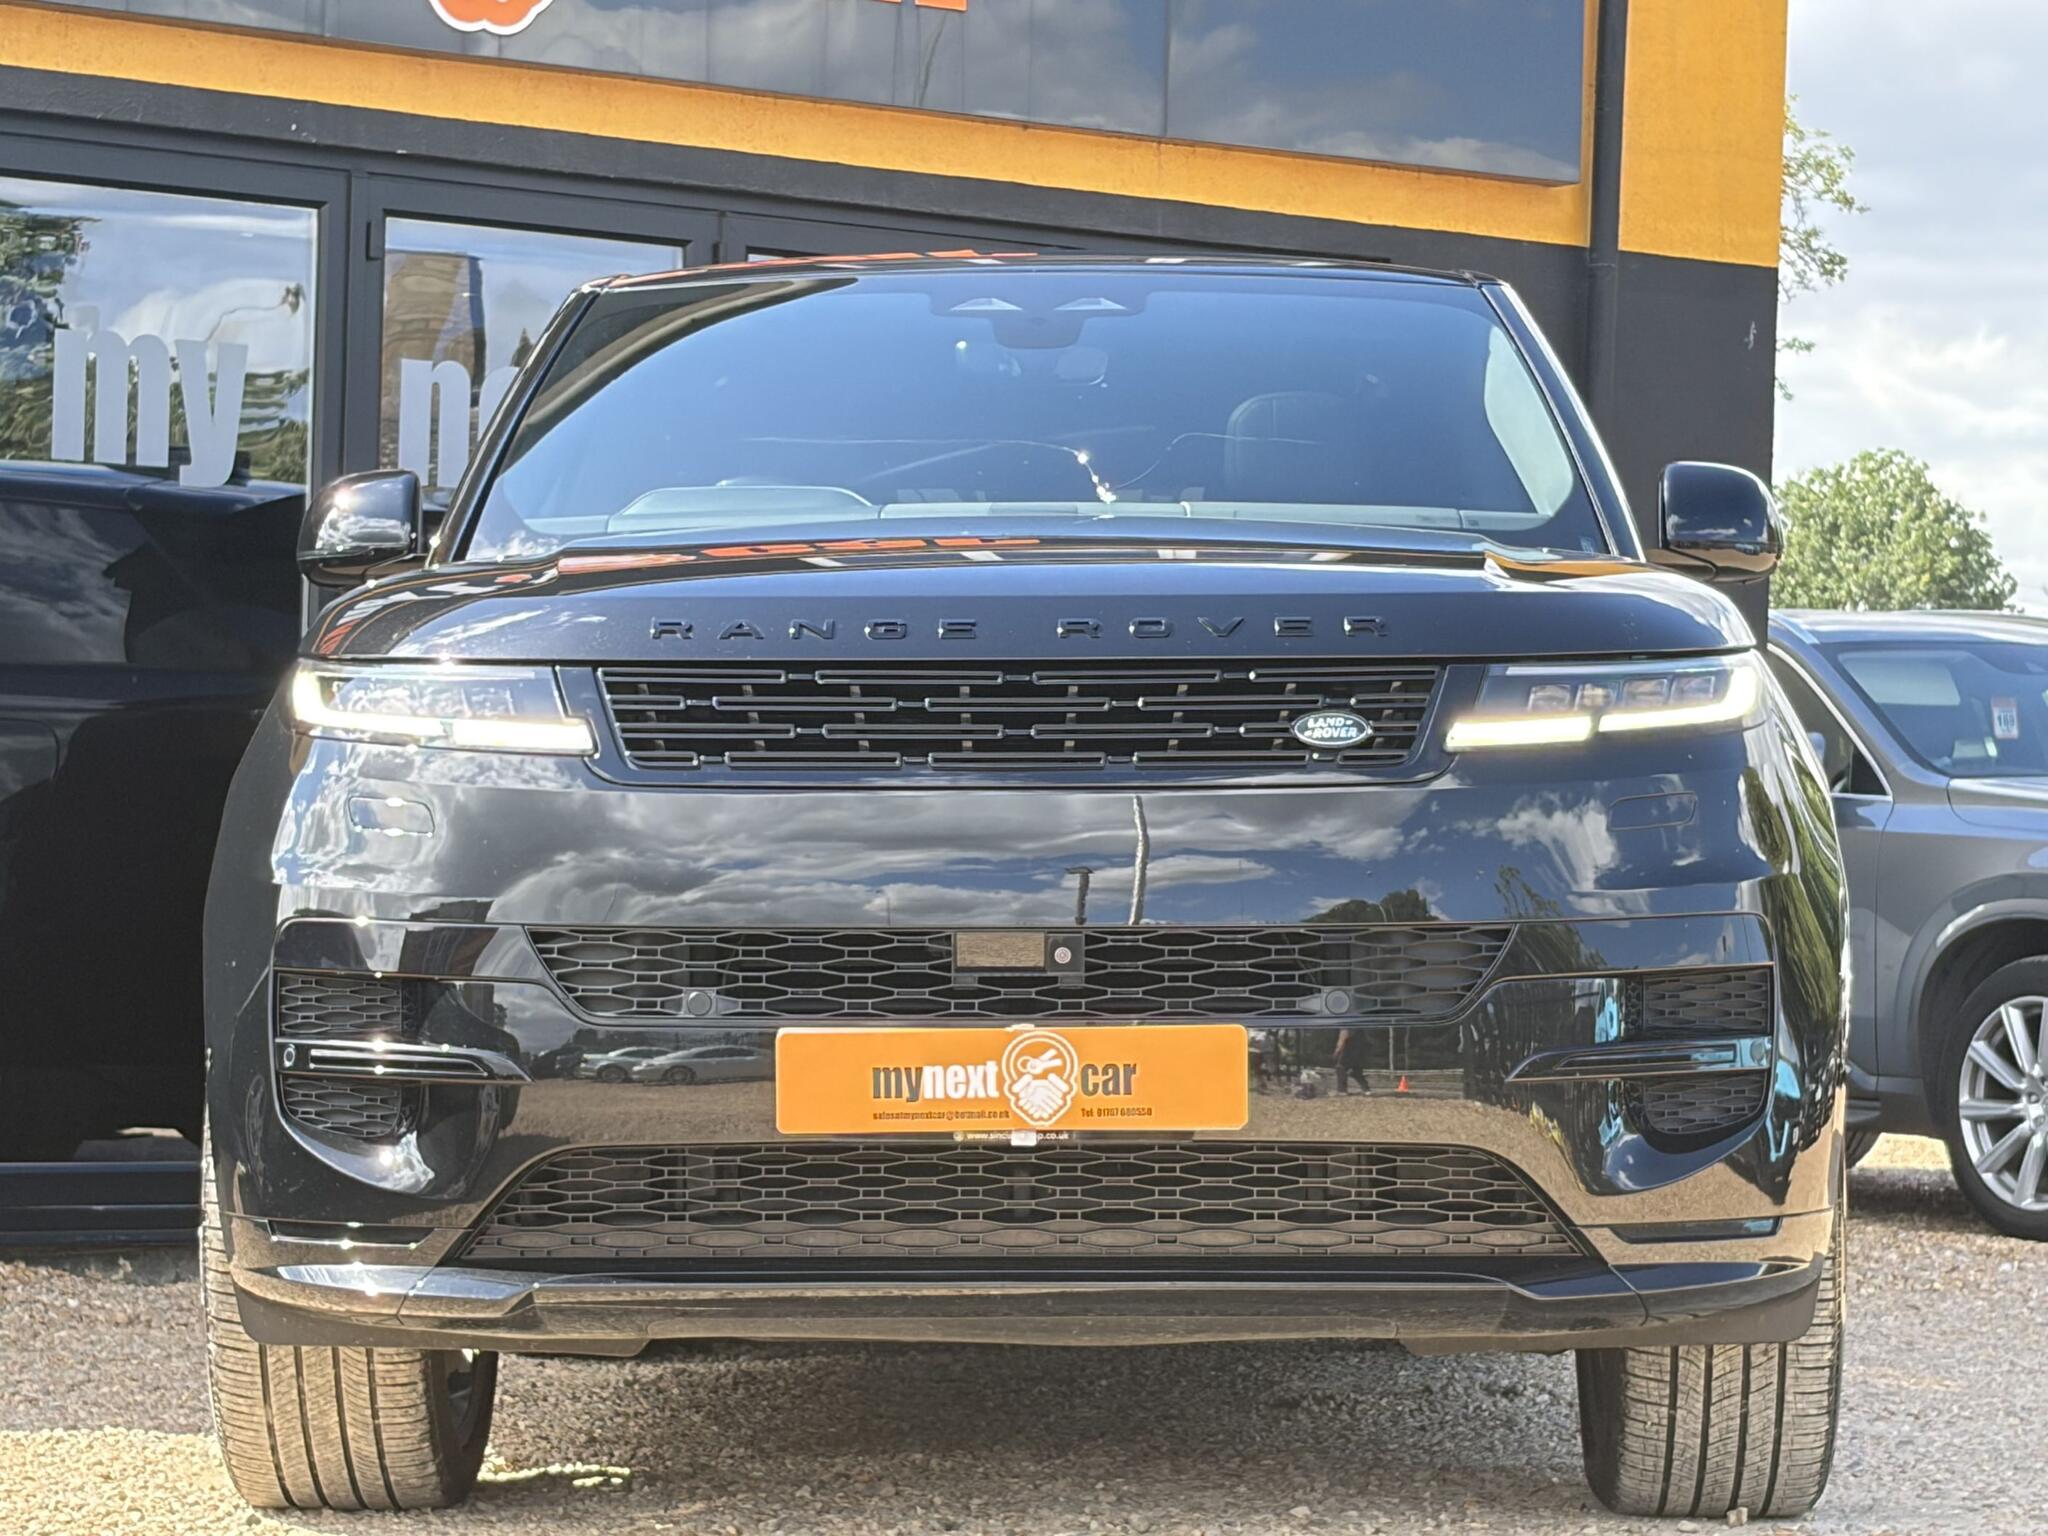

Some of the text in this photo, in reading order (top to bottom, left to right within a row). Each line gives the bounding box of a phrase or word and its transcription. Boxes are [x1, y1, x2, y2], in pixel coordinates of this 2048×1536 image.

[51, 328, 249, 488] my
[651, 616, 1390, 640] RANGE ROVER
[1080, 1063, 1137, 1097] car
